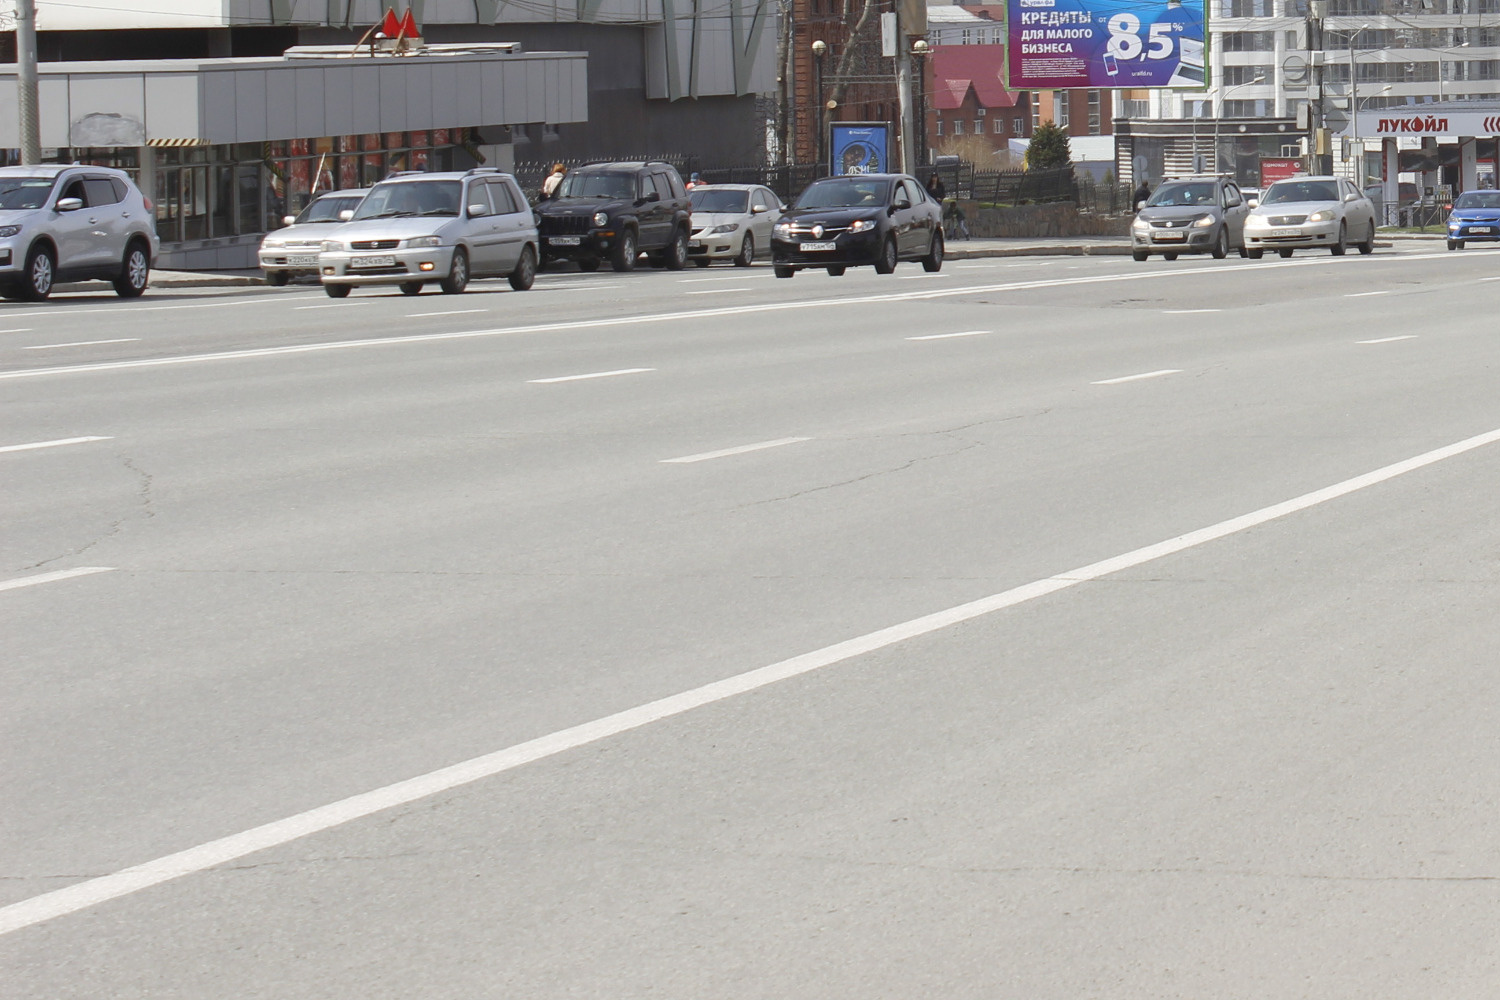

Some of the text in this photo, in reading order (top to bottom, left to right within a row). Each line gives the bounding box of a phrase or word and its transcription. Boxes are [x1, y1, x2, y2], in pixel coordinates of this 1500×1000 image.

[1021, 11, 1092, 27] КРЕДИТЫ
[1021, 29, 1093, 41] ДЛЯ МАЛОГО
[1021, 43, 1073, 54] БИЗНЕСА
[1377, 115, 1448, 132] ЛУКОЙЛ
